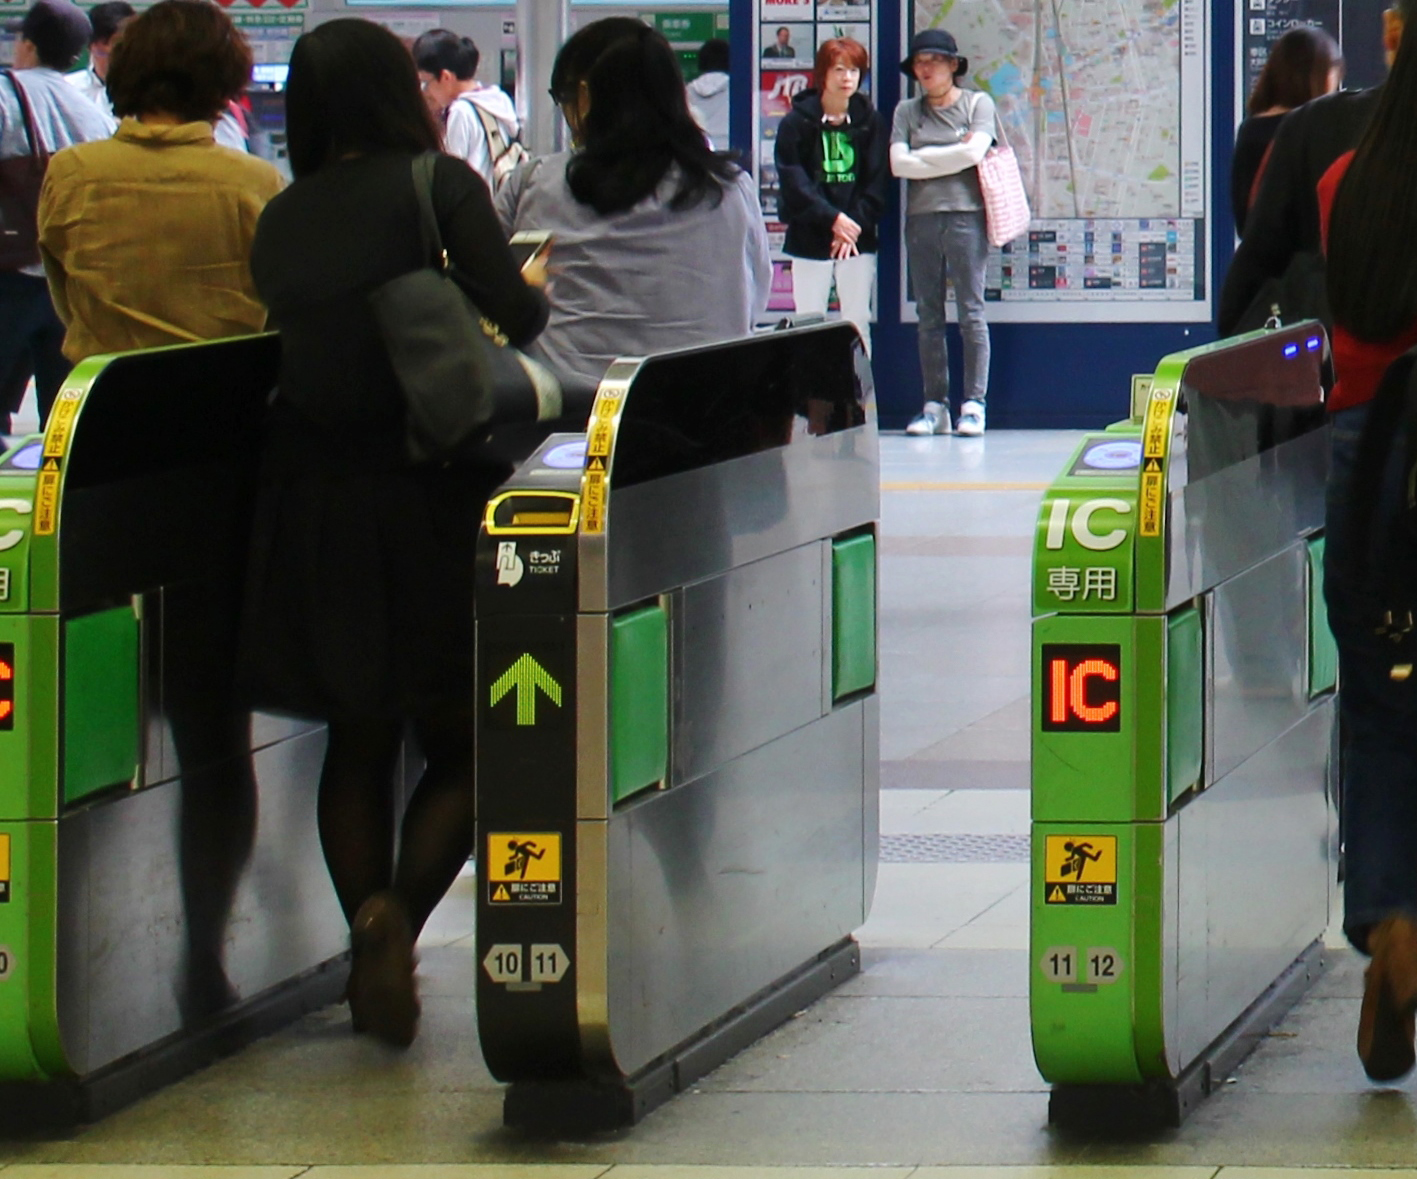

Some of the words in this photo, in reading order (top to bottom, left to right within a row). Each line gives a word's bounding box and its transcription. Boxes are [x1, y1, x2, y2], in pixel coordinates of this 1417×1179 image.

[1046, 498, 1130, 551] IC
[529, 550, 561, 564] きっぷ
[529, 565, 559, 574] TICKET
[1046, 566, 1117, 601] 専用
[1050, 659, 1118, 724] IC
[511, 883, 555, 894] 扉にご注意
[494, 952, 518, 975] 10
[536, 952, 558, 975] 11
[1049, 953, 1072, 976] 11
[1090, 953, 1115, 976] 12
